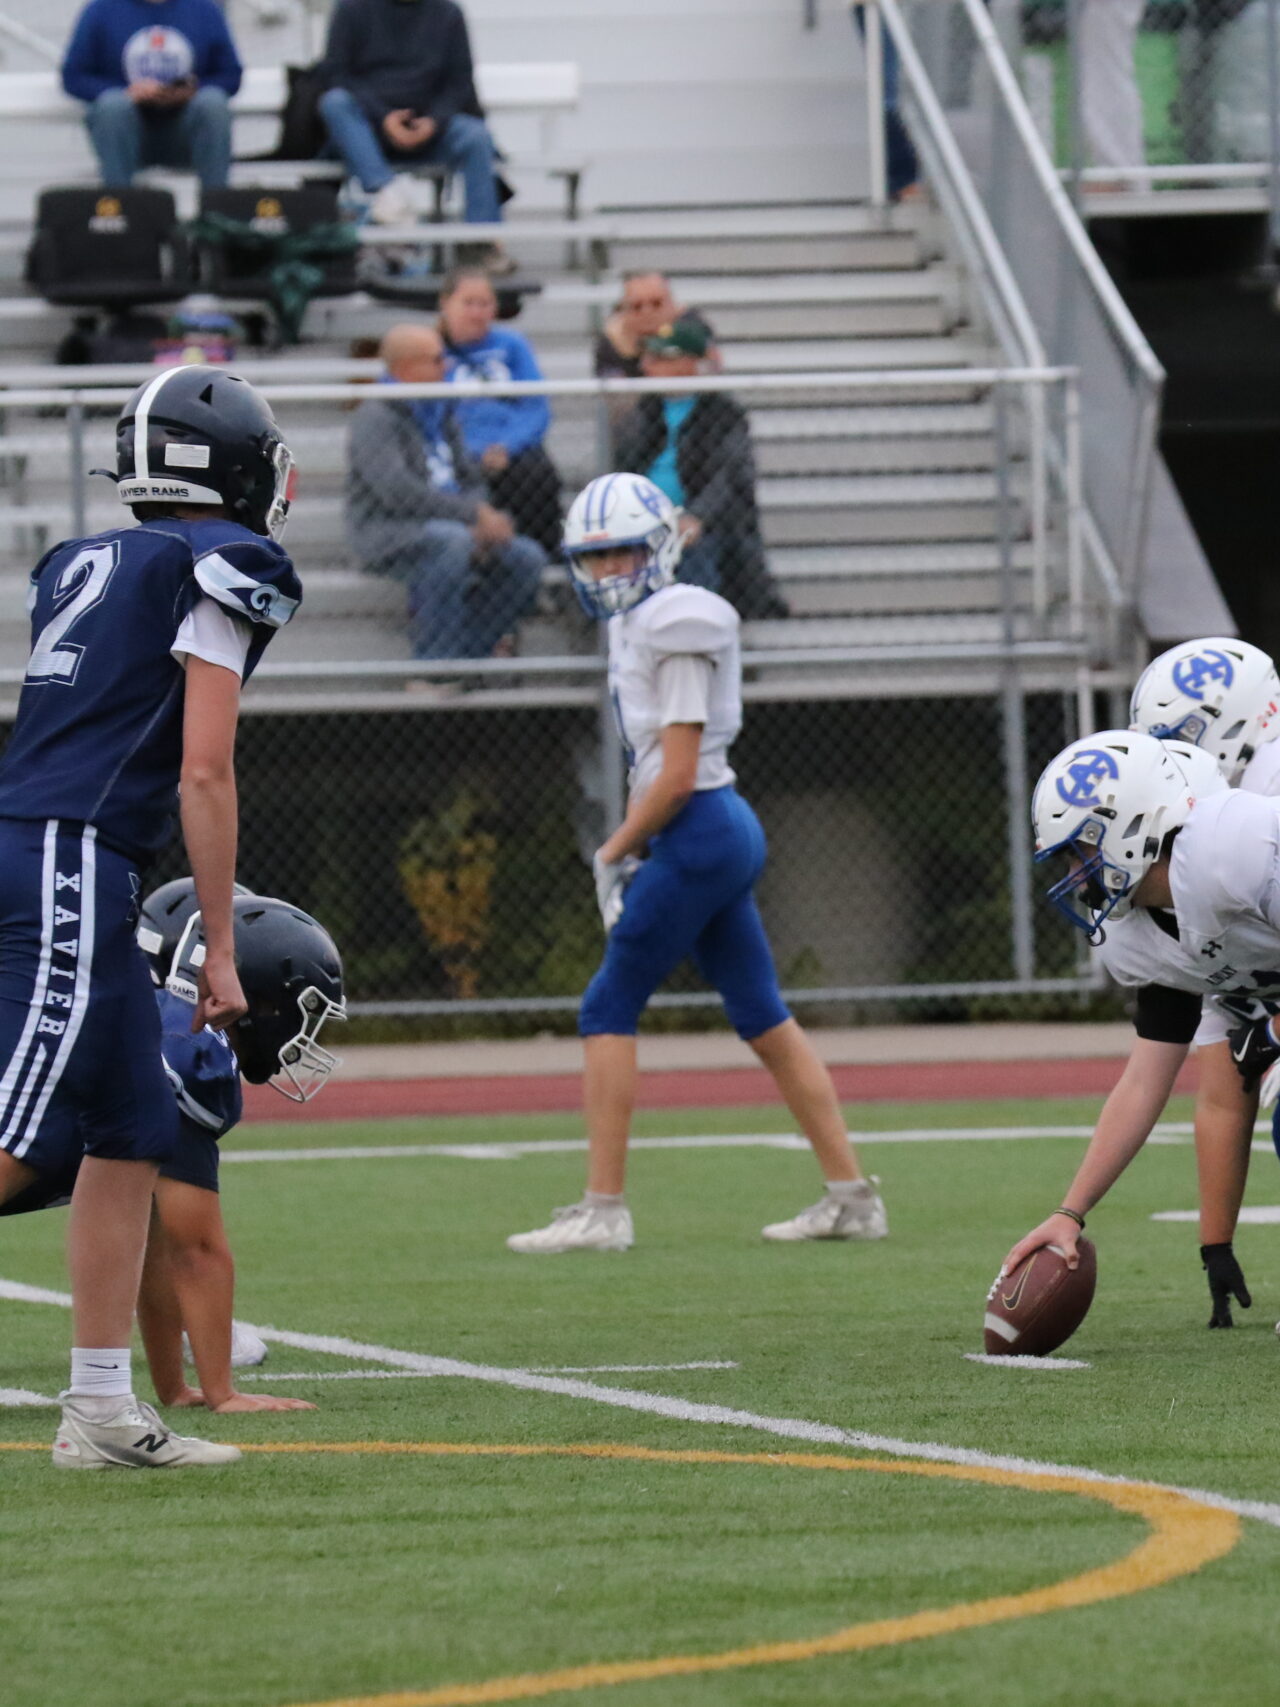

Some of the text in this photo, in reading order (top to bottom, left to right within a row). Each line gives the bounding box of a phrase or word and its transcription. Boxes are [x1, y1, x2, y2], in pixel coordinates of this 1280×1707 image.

[152, 487, 189, 498] RAMS
[23, 540, 120, 686] 2
[37, 872, 81, 1036] XAVIER
[172, 983, 197, 1000] RAMS
